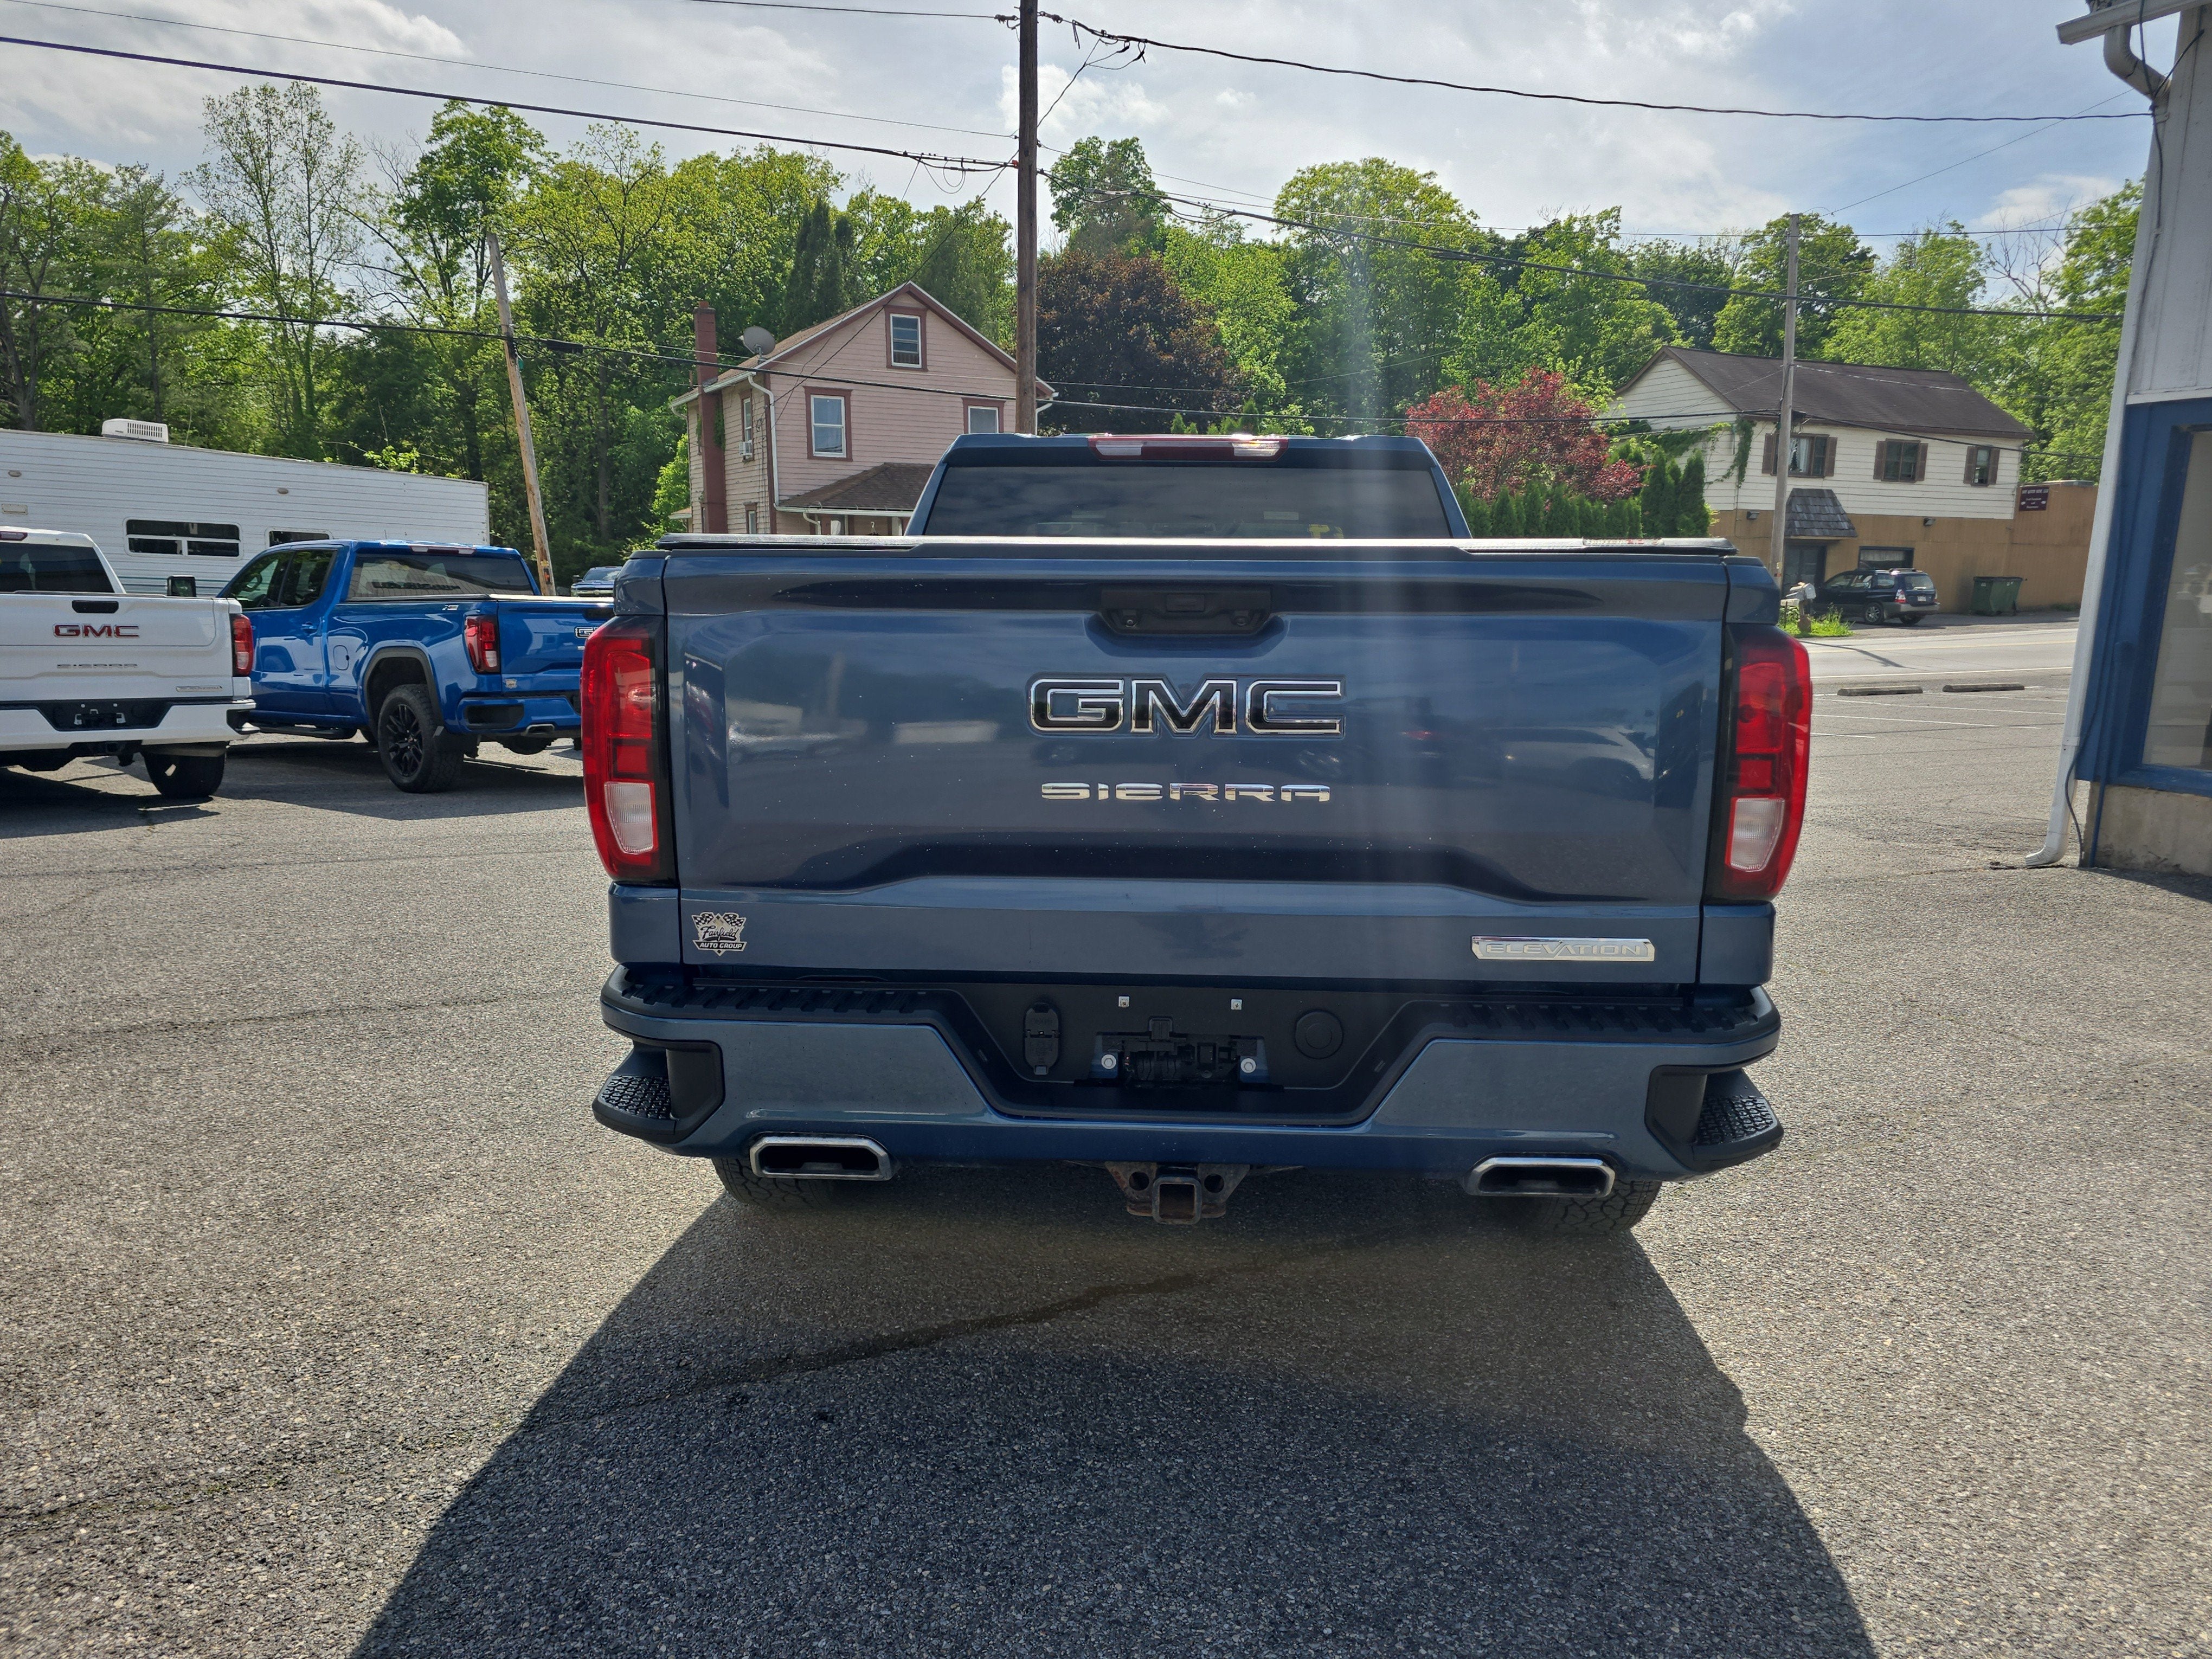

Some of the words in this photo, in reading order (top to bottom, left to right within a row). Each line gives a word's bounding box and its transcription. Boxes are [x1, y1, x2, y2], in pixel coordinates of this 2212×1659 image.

[53, 623, 140, 638] GMC
[1029, 678, 1342, 735] GMC
[1041, 782, 1330, 802] SIERRA
[700, 925, 739, 941] Fairfield
[1486, 943, 1641, 956] ELEVATION
